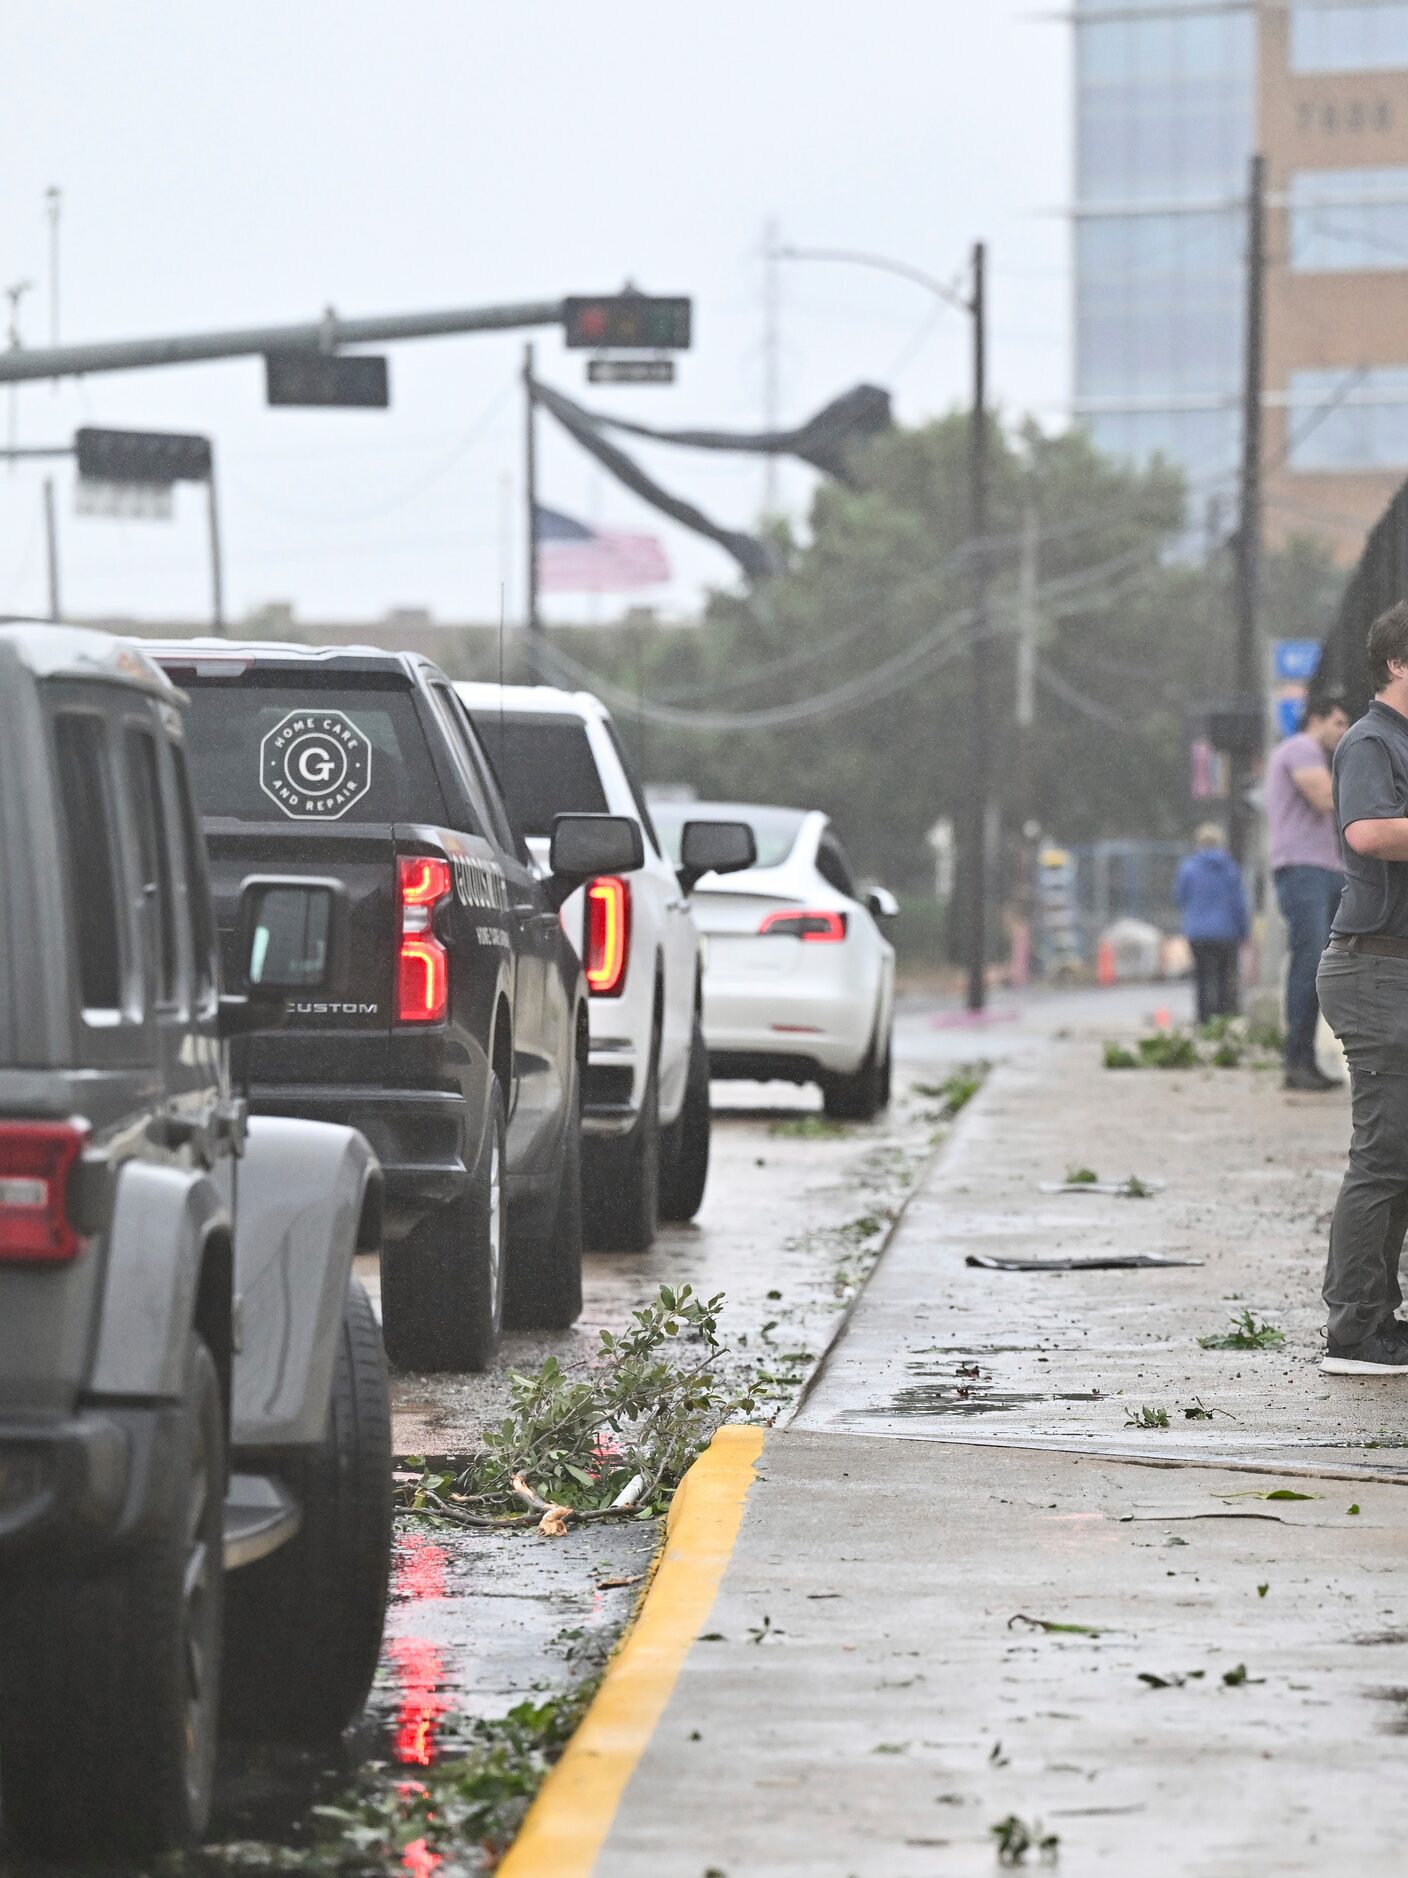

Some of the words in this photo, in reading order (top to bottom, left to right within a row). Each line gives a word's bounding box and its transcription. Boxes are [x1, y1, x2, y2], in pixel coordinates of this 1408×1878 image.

[275, 718, 314, 748] HOME
[323, 719, 358, 749] CARE
[299, 747, 335, 781] G
[273, 779, 298, 804] AND
[306, 780, 357, 810] REPAIR
[286, 1003, 377, 1014] CUSTOM
